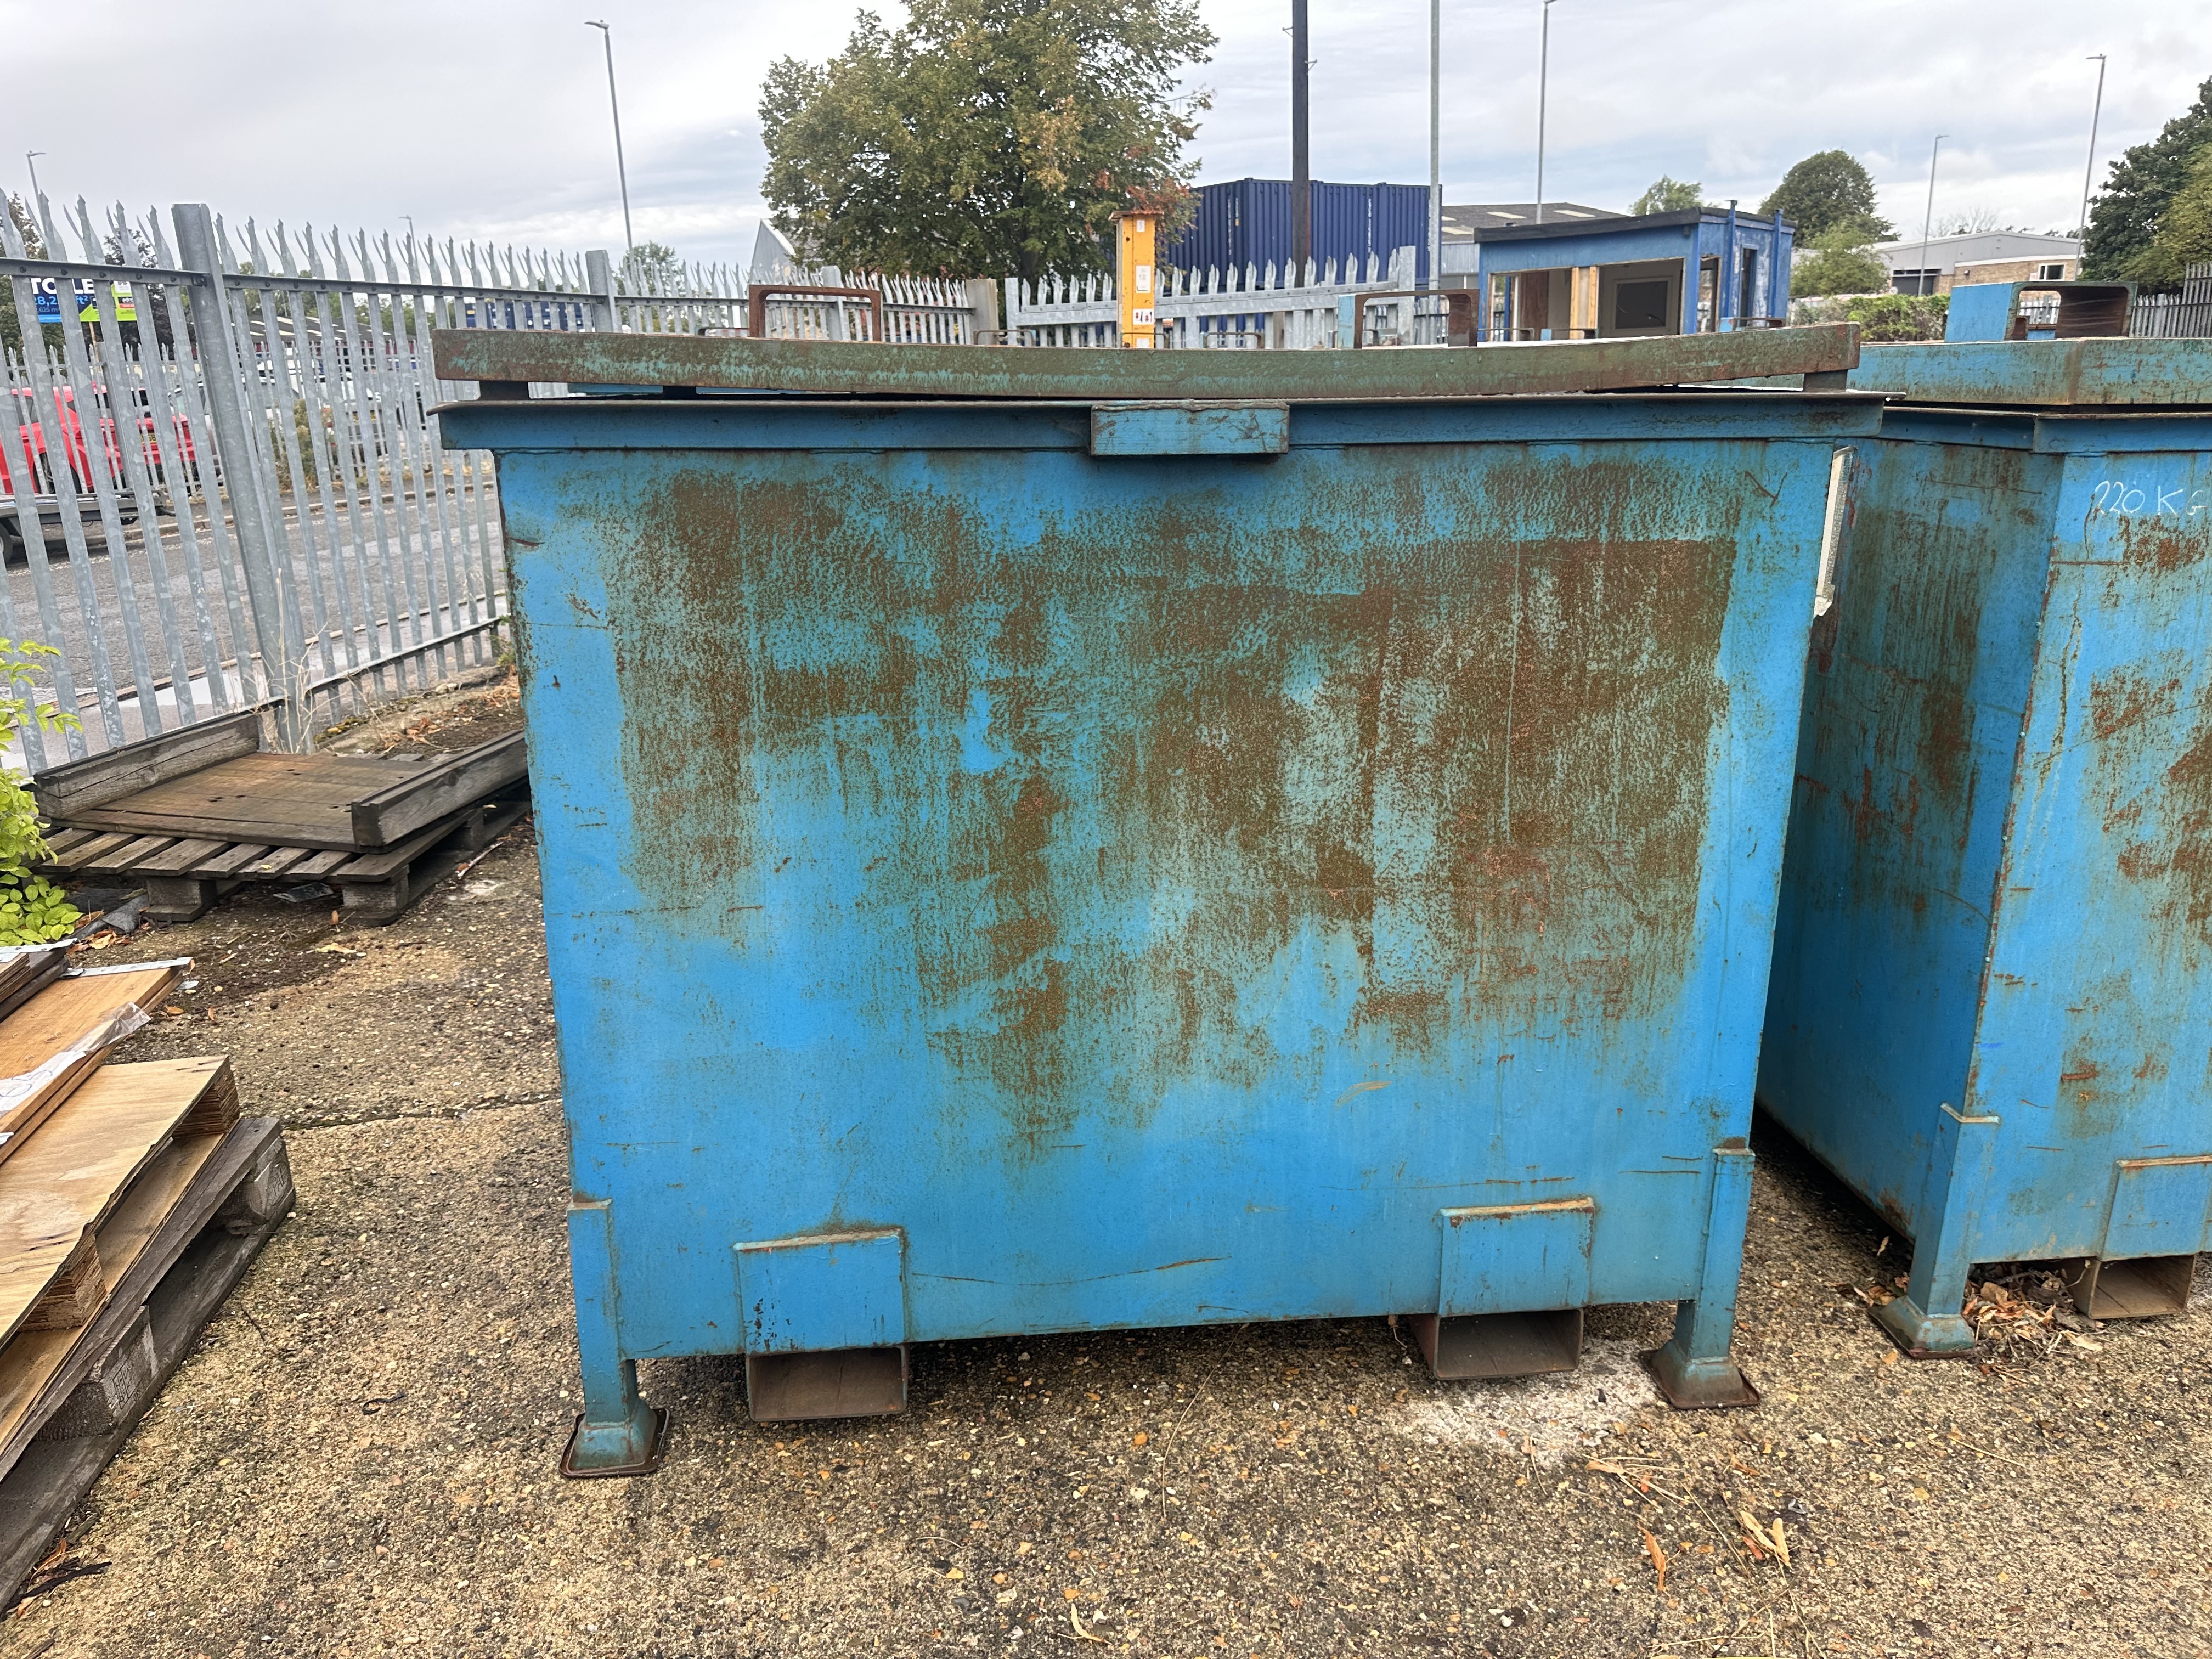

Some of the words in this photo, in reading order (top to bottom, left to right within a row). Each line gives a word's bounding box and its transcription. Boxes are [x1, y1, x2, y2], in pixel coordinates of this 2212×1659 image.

[71, 278, 95, 294] LE
[2093, 481, 2146, 516] 220
[2157, 486, 2209, 517] KG
